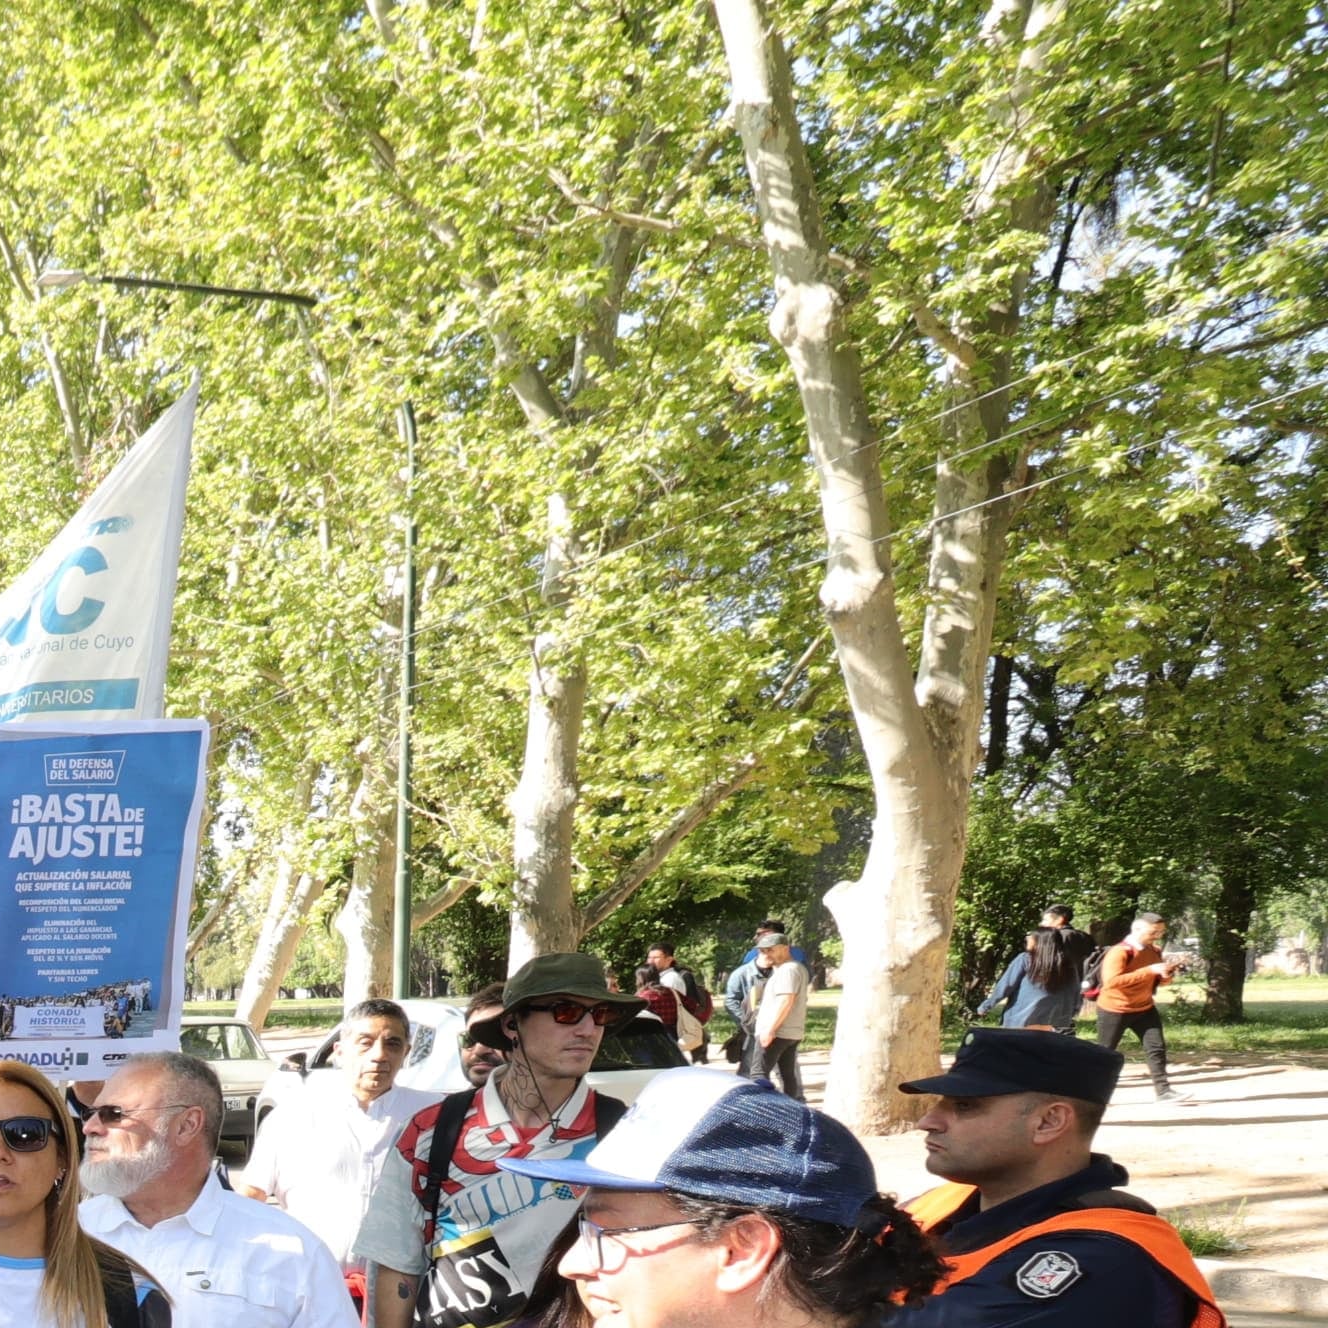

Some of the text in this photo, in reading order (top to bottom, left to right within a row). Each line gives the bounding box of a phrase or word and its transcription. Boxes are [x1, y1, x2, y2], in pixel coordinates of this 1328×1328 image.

[68, 632, 135, 653] de Cuyo
[52, 757, 114, 769] EN DEFENSA
[50, 768, 115, 780] DEL SALARIO
[10, 793, 145, 825] ¡BASTA DE
[8, 824, 145, 866] AJUSTE!
[16, 869, 132, 881] ACTUALIZACIÓN SALARIAL
[15, 879, 132, 893] QUE SUPERE LA INFLACIÓN
[36, 1009, 81, 1017] CONADU
